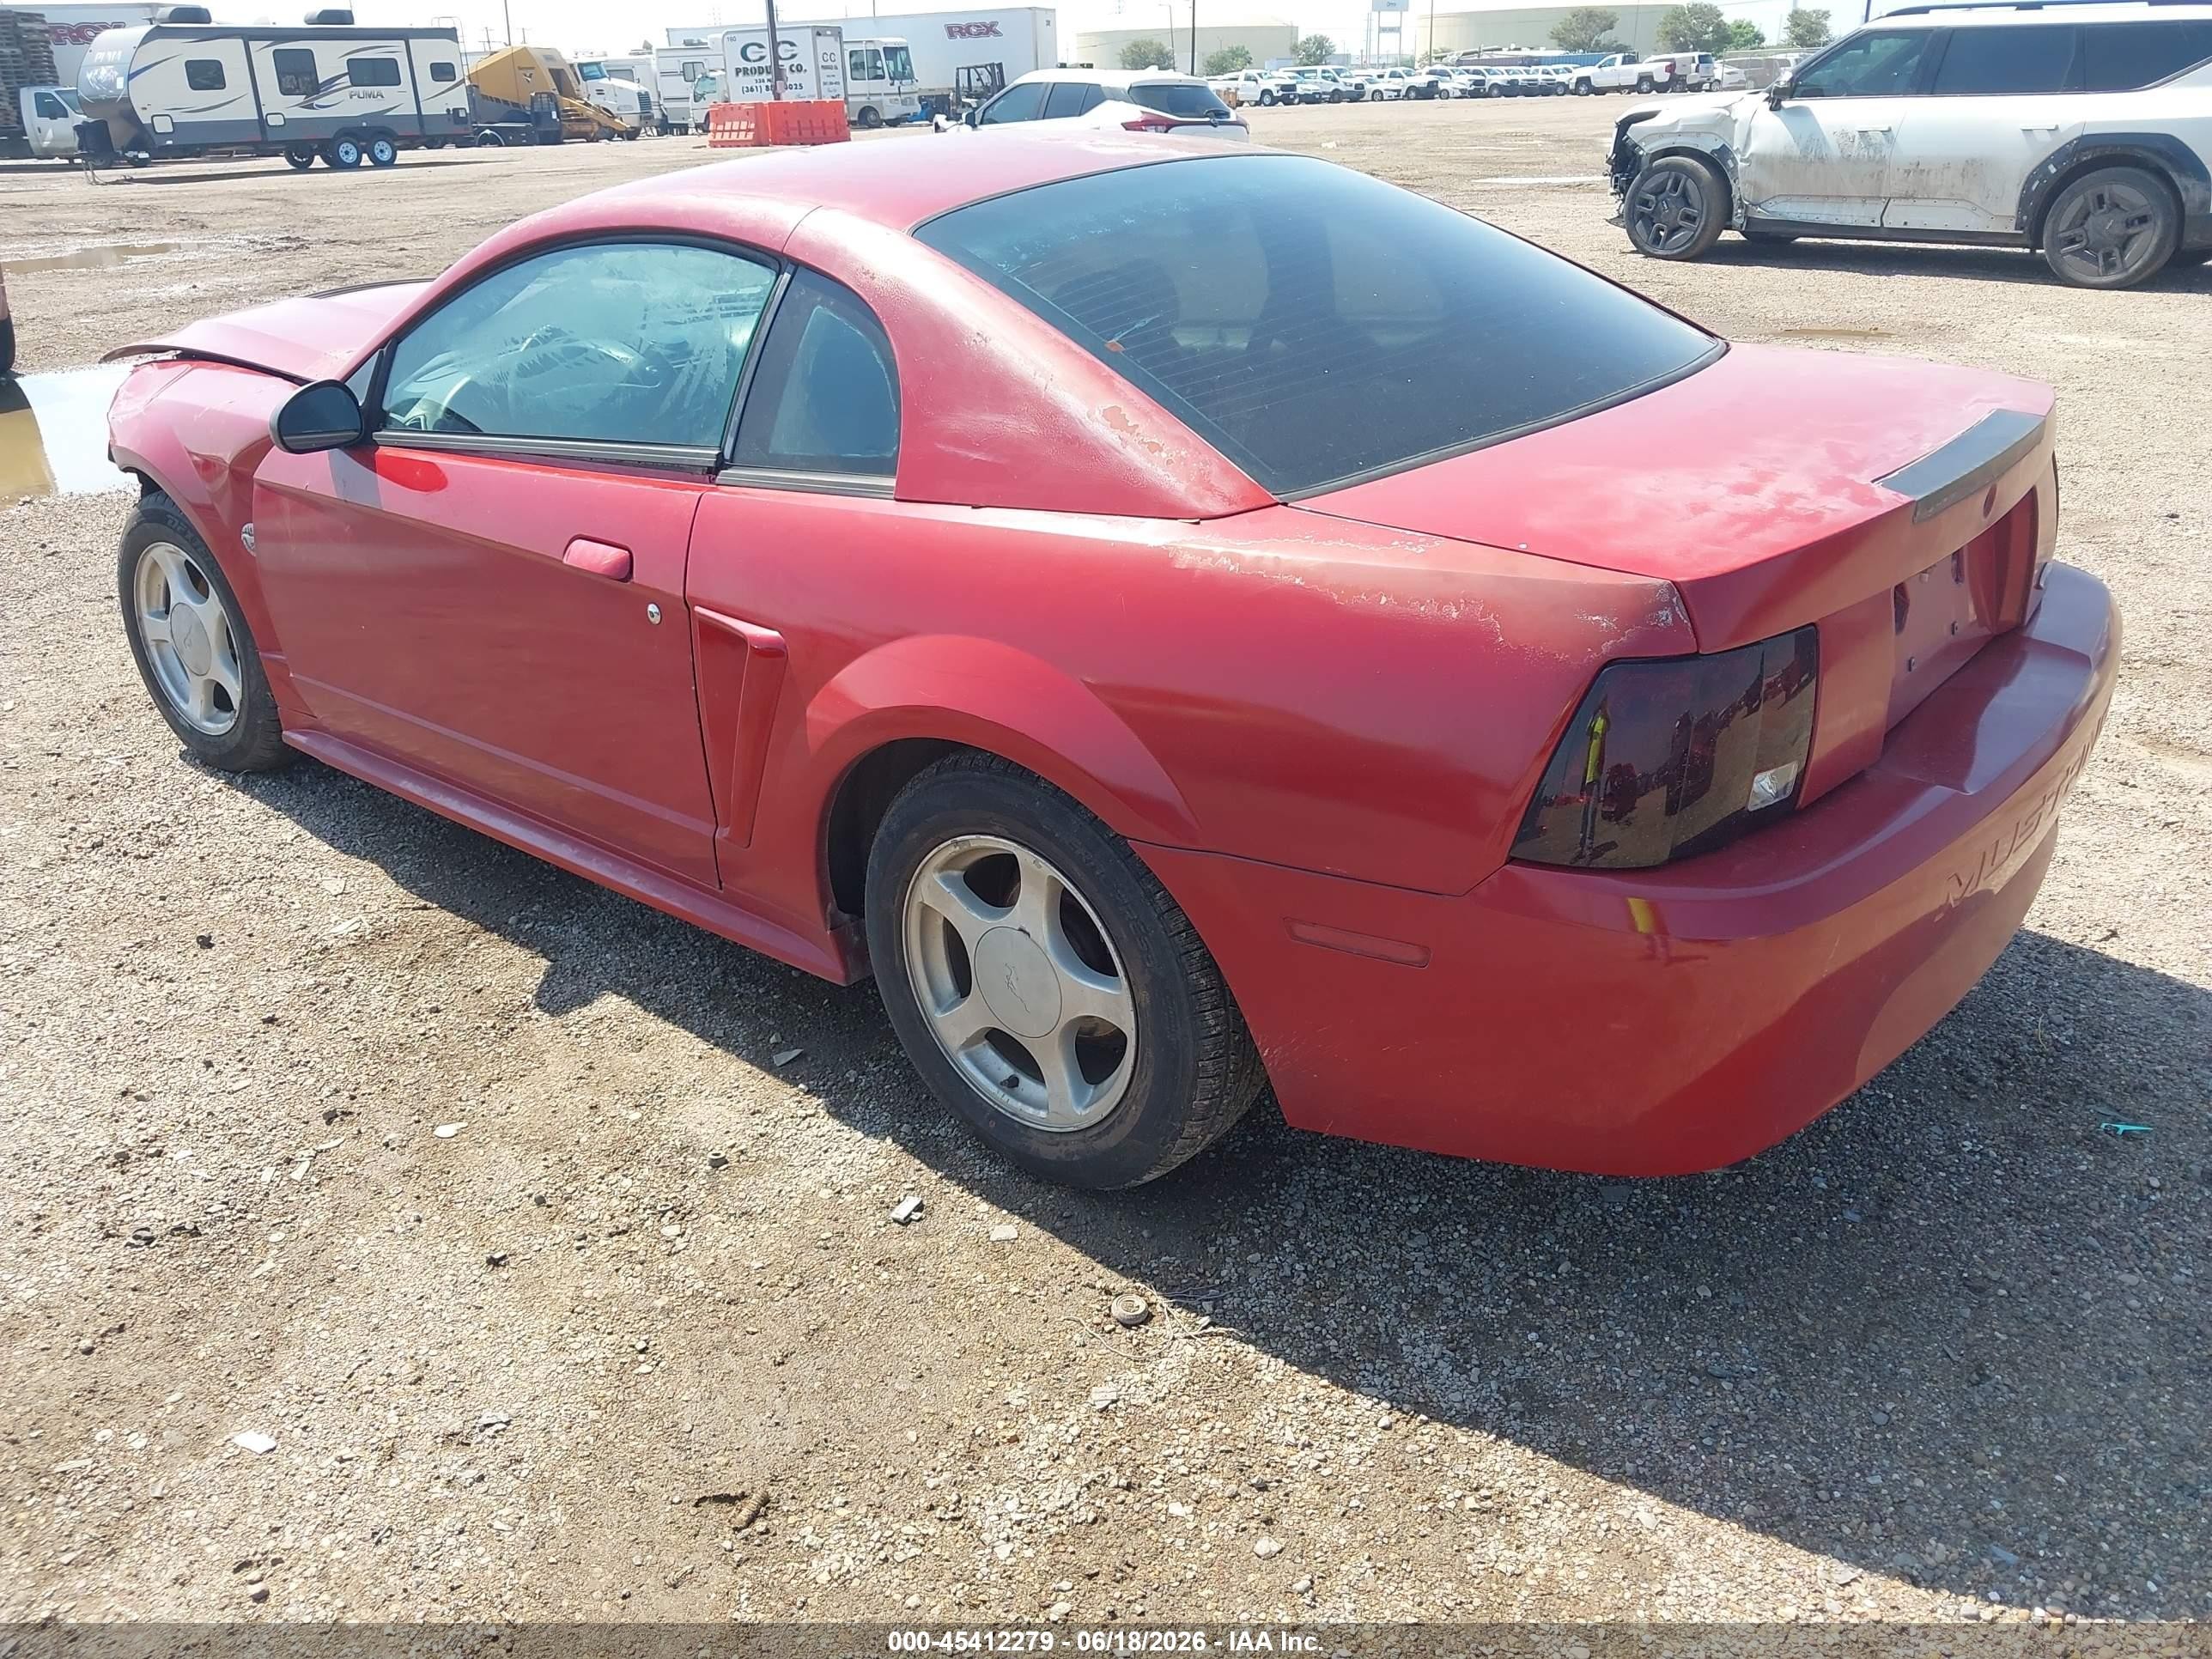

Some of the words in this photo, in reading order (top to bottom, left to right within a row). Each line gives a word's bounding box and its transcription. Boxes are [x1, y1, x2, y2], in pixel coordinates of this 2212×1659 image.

[944, 21, 1004, 40] RCX
[822, 52, 836, 63] CC
[735, 64, 785, 76] PRODU
[789, 64, 807, 73] CO.
[349, 89, 386, 100] PUMA
[742, 85, 763, 94] (361)
